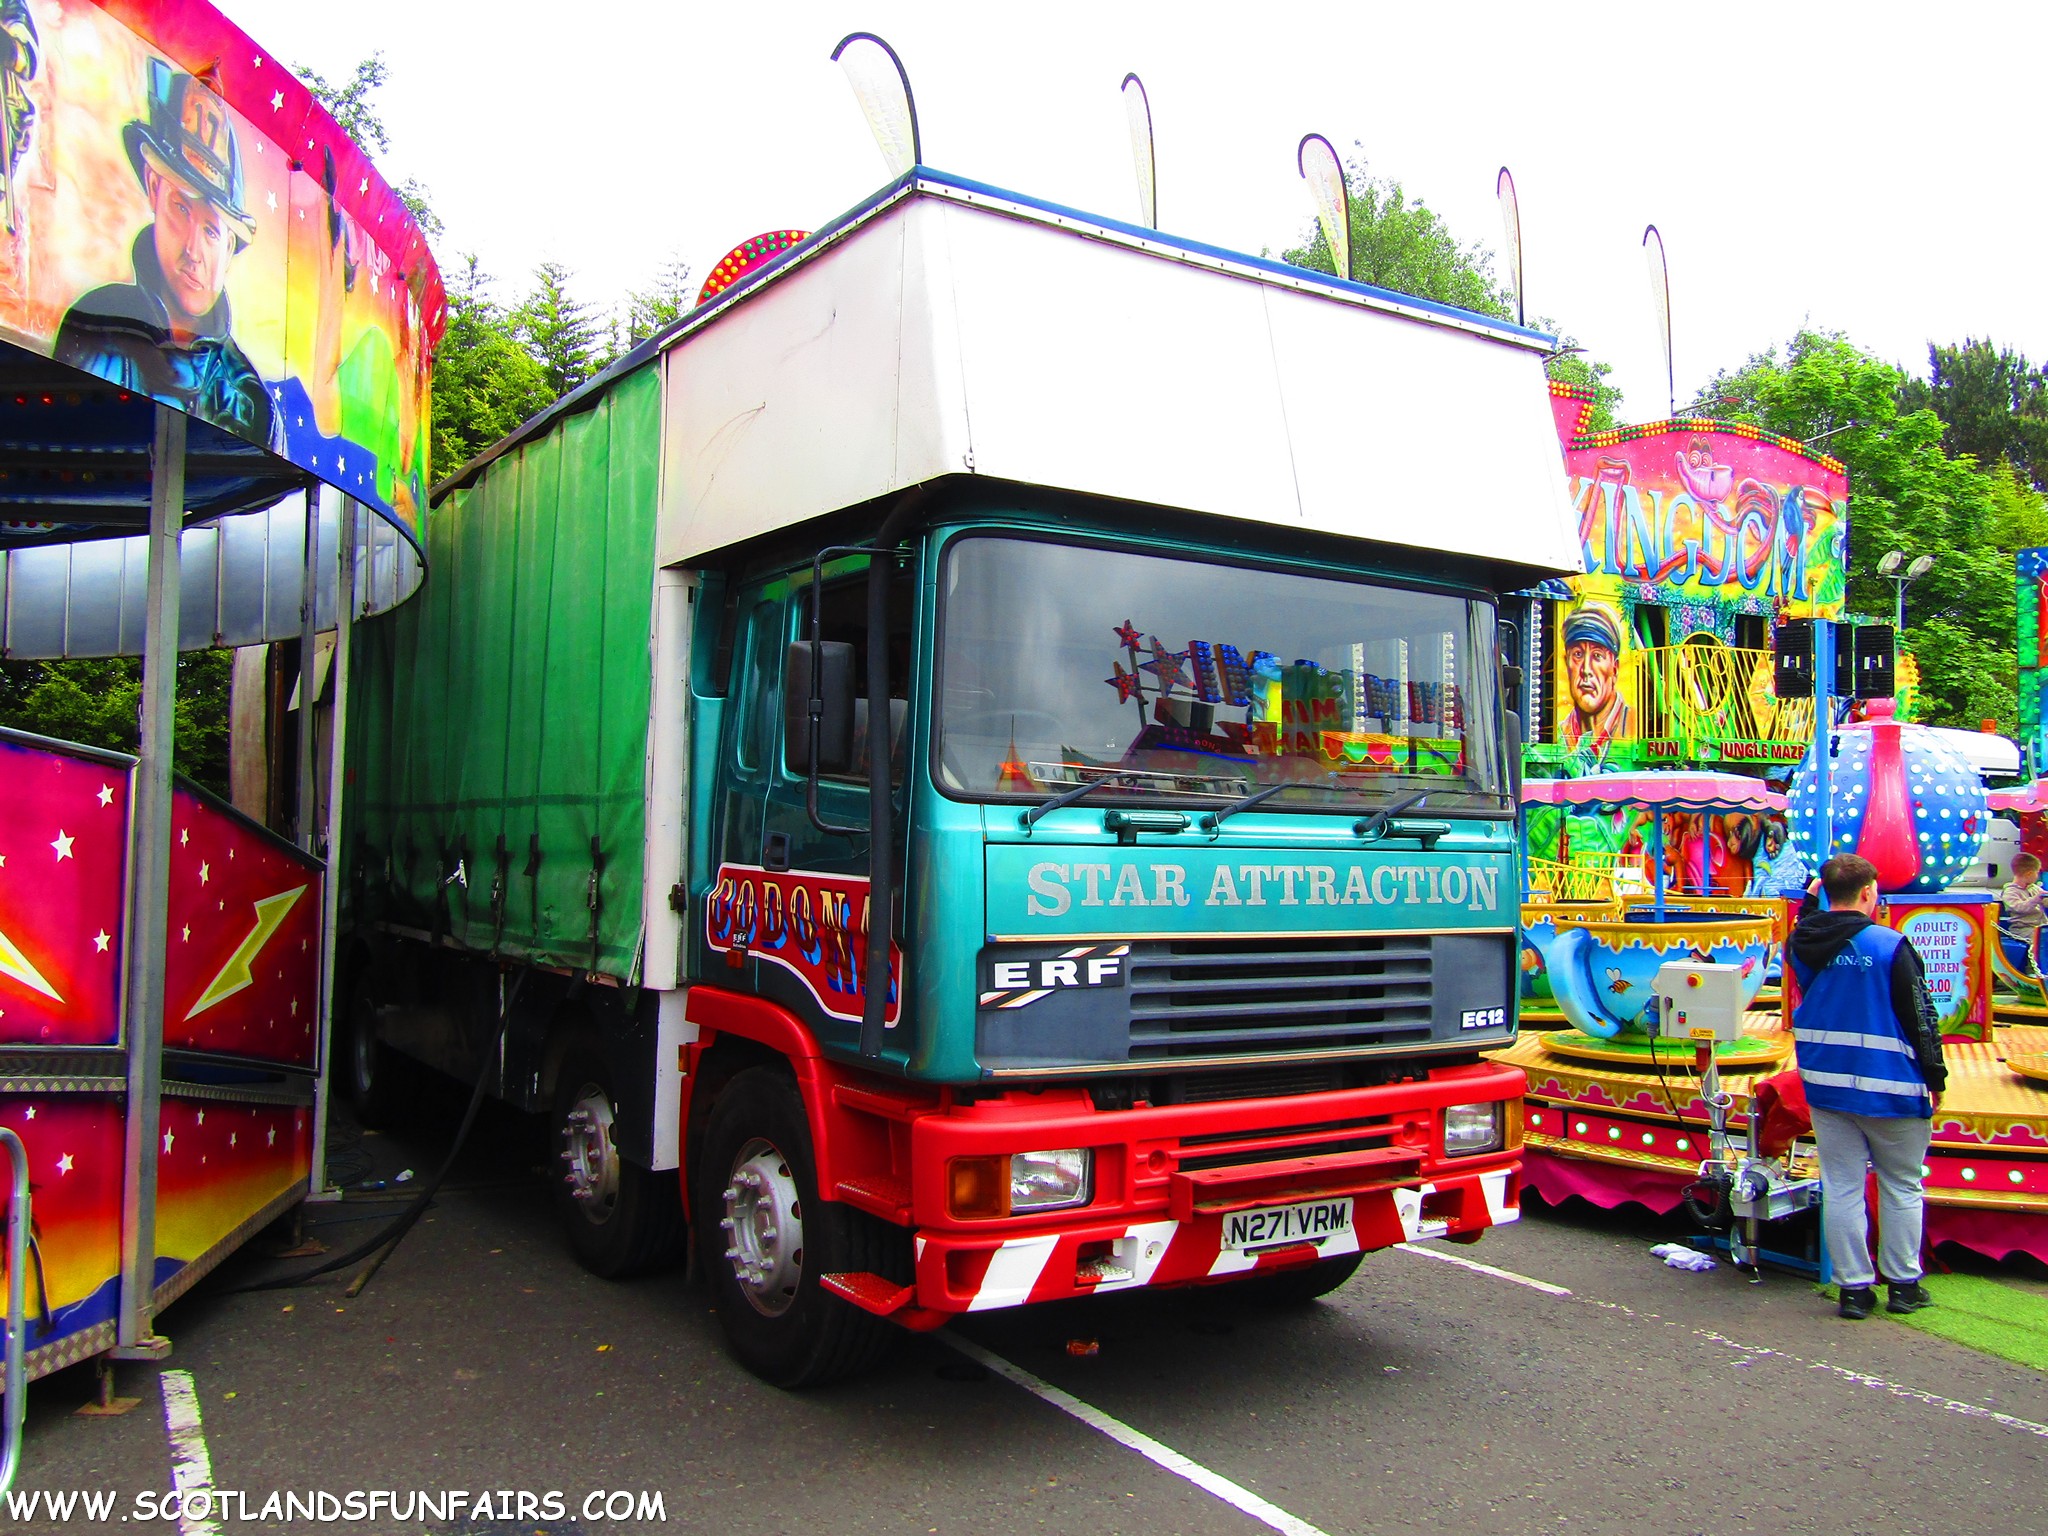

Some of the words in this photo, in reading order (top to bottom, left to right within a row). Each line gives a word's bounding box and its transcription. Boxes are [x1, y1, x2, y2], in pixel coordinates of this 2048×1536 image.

[1647, 740, 1680, 757] FUN
[1720, 741, 1768, 761] JUNGLE
[1772, 744, 1805, 760] MAZE
[1027, 862, 1190, 917] STAR
[1204, 864, 1498, 911] ATTRACTION
[1914, 922, 1959, 933] ADULTS
[1912, 936, 1932, 947] MAY
[1934, 935, 1957, 946] RIDE
[994, 957, 1122, 989] ERF
[1925, 962, 1960, 974] ILDREN
[1926, 979, 1951, 993] 3.00
[1462, 1008, 1505, 1028] EC12
[1231, 1209, 1290, 1245] N271
[1297, 1202, 1347, 1235] VRM
